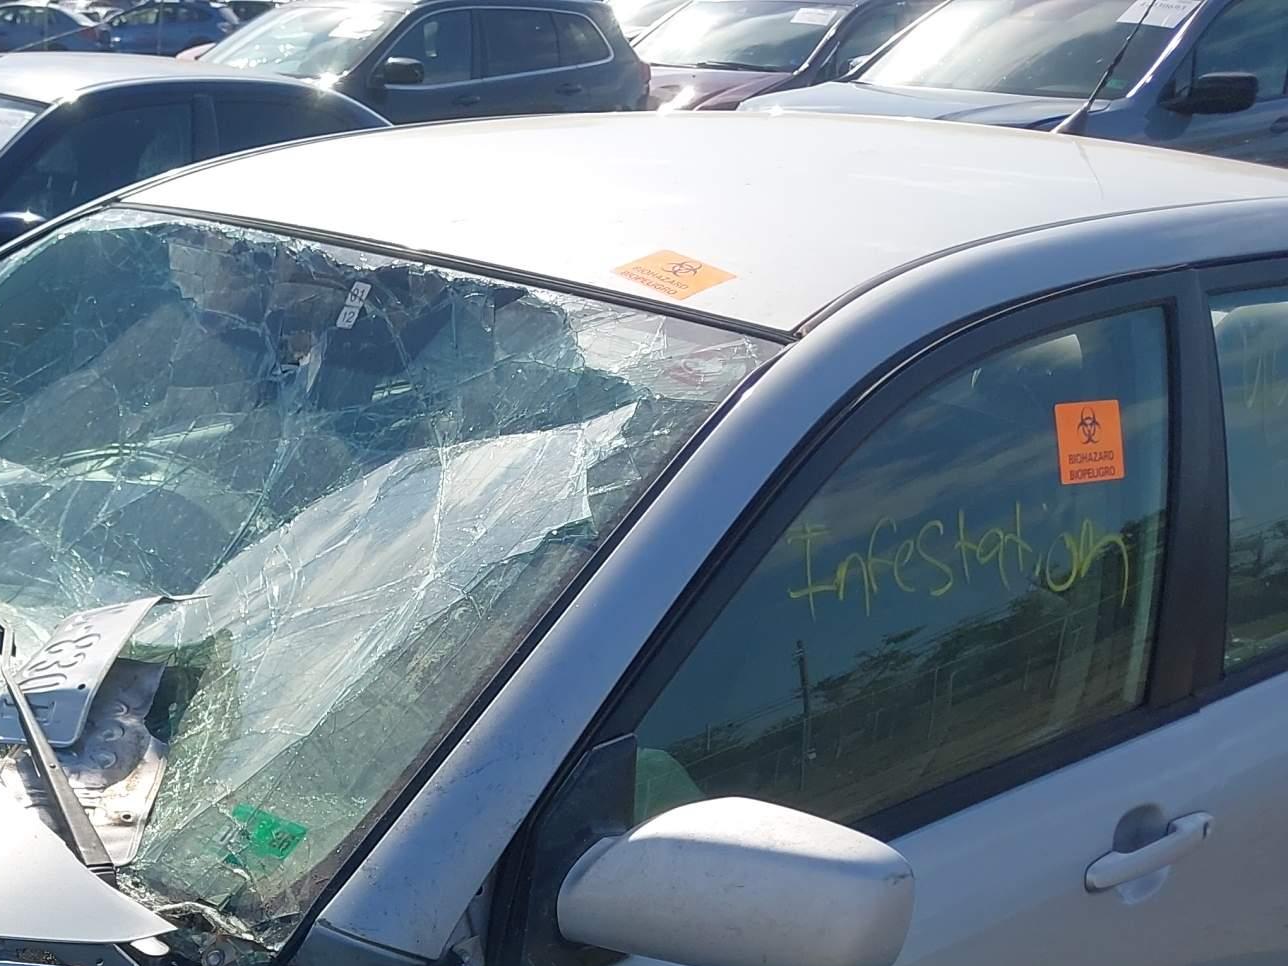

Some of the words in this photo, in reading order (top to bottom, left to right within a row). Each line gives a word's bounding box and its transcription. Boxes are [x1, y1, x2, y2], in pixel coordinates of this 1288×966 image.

[343, 311, 355, 323] 12
[1067, 450, 1114, 465] BIOHAZARD
[1069, 465, 1116, 481] BIOPELIGRO
